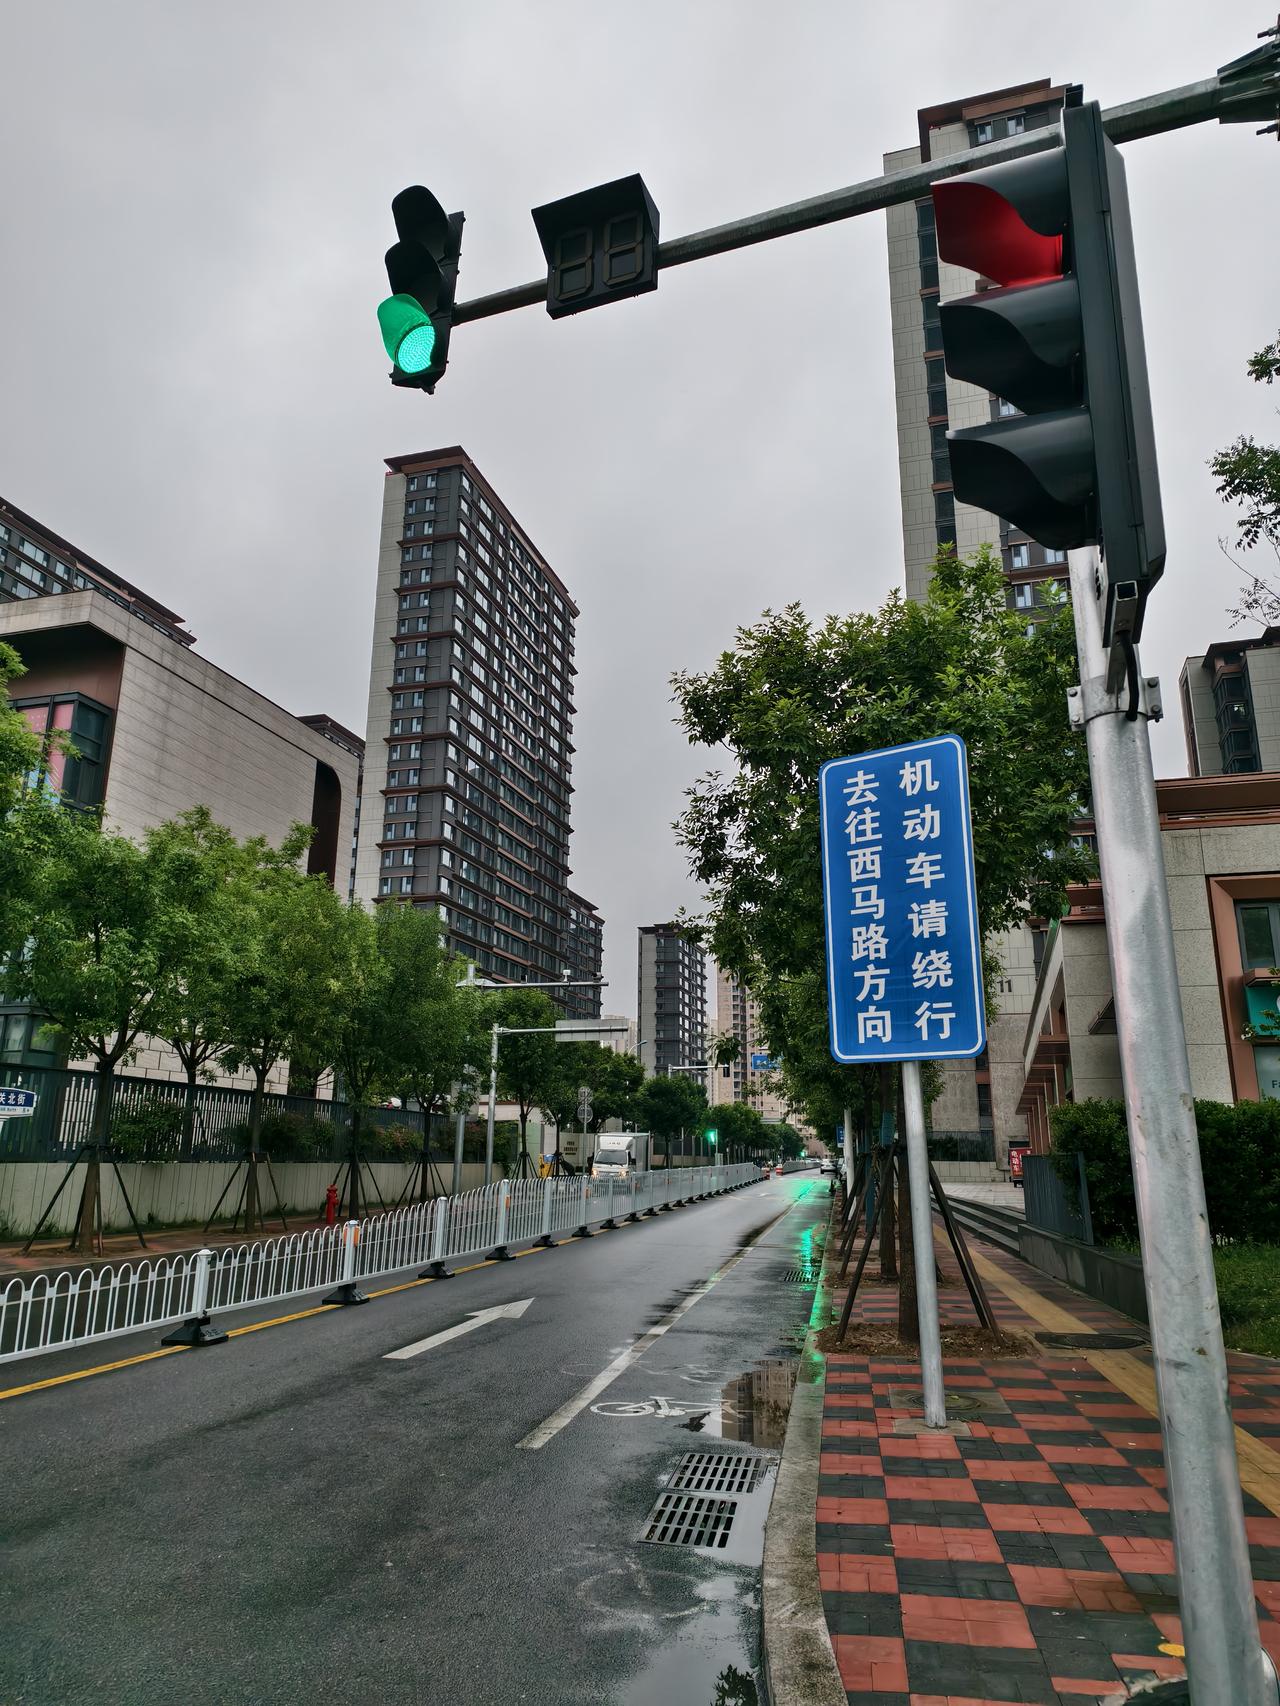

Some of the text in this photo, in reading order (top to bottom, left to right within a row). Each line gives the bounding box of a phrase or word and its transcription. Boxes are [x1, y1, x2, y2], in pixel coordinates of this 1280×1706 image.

[843, 770, 892, 1044] 去往西马路方向
[899, 758, 956, 1041] 机动车请绕行
